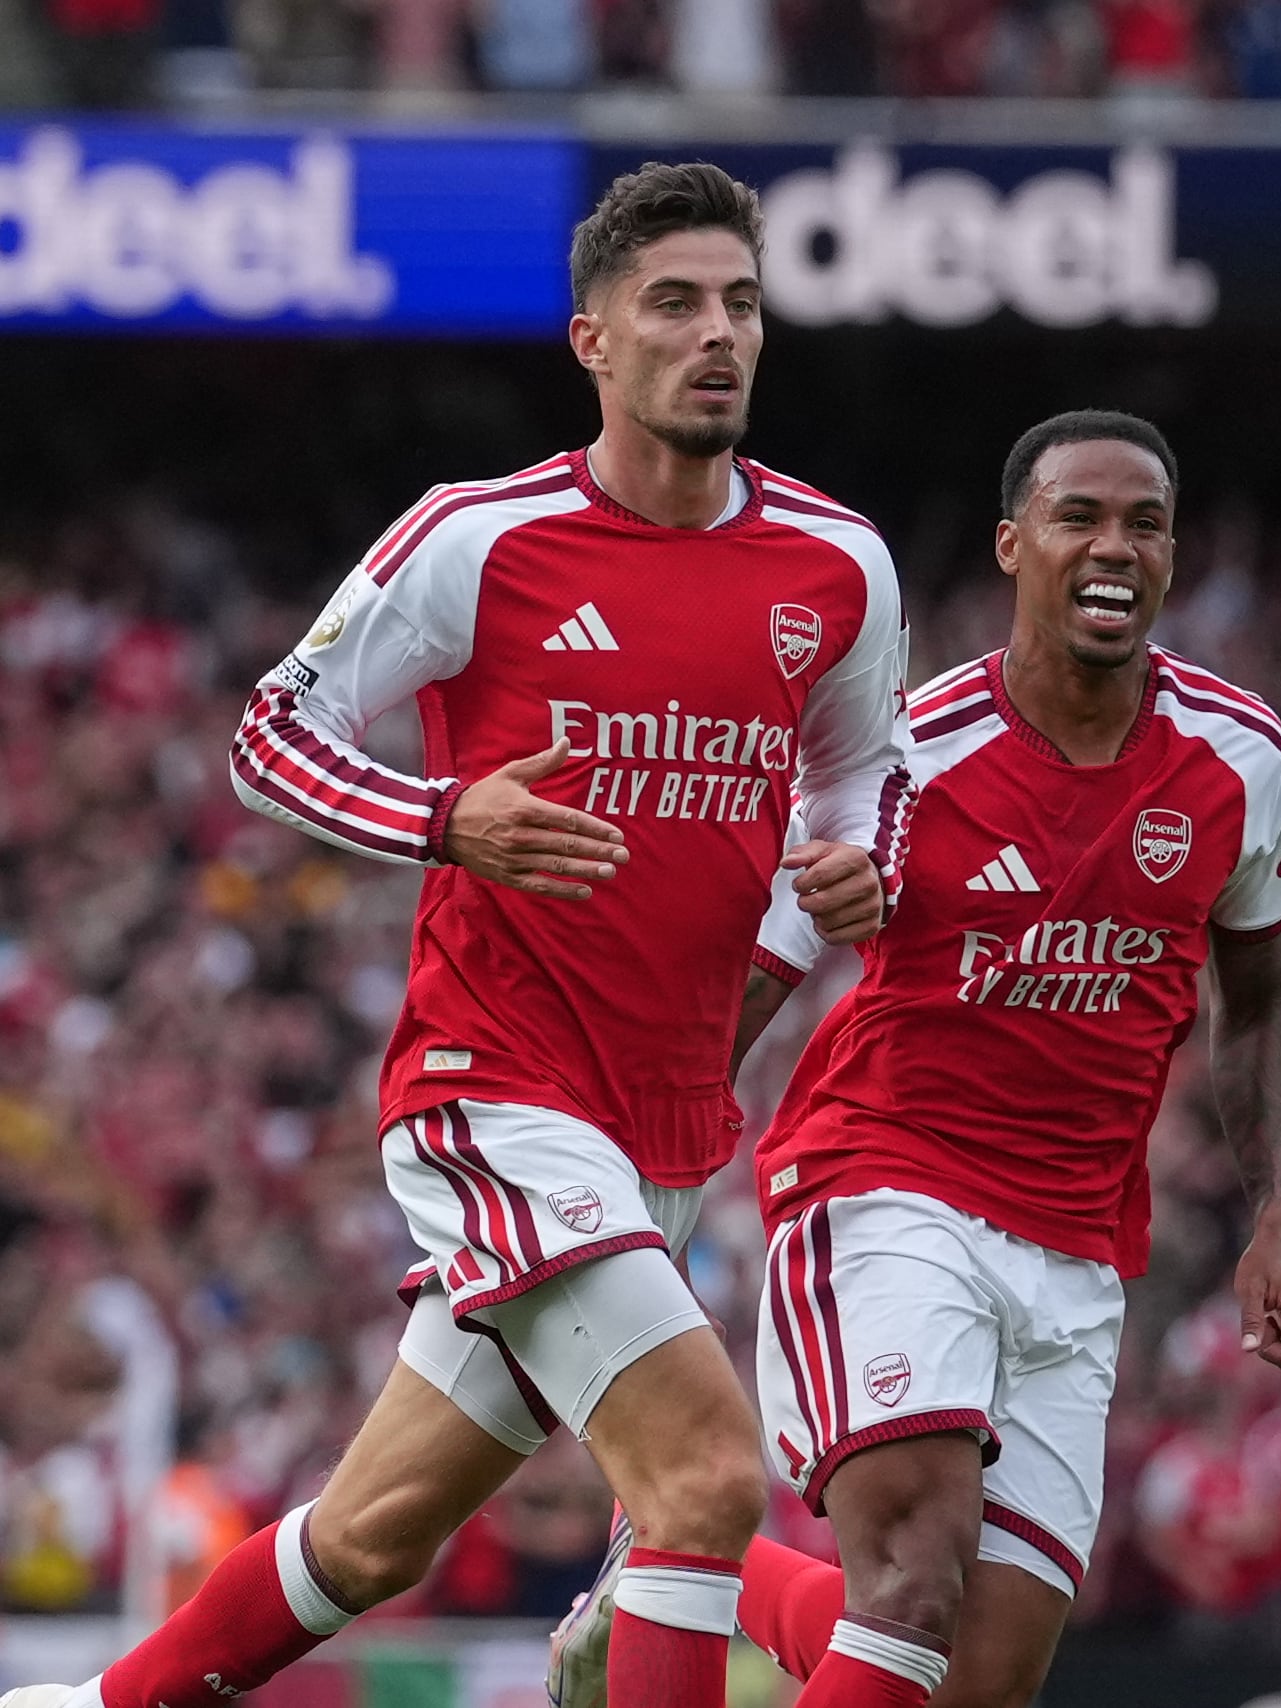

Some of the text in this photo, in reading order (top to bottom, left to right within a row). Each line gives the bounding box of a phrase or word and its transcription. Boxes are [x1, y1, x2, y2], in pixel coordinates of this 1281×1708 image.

[764, 135, 1218, 328] deel.
[779, 614, 816, 633] Arsenal
[283, 655, 310, 684] oom
[548, 699, 793, 771] Emirates
[585, 767, 769, 822] FLY BETTER
[1142, 820, 1183, 837] Arsenal
[1004, 972, 1131, 1013] BETTER
[870, 1360, 903, 1378] Arsenal
